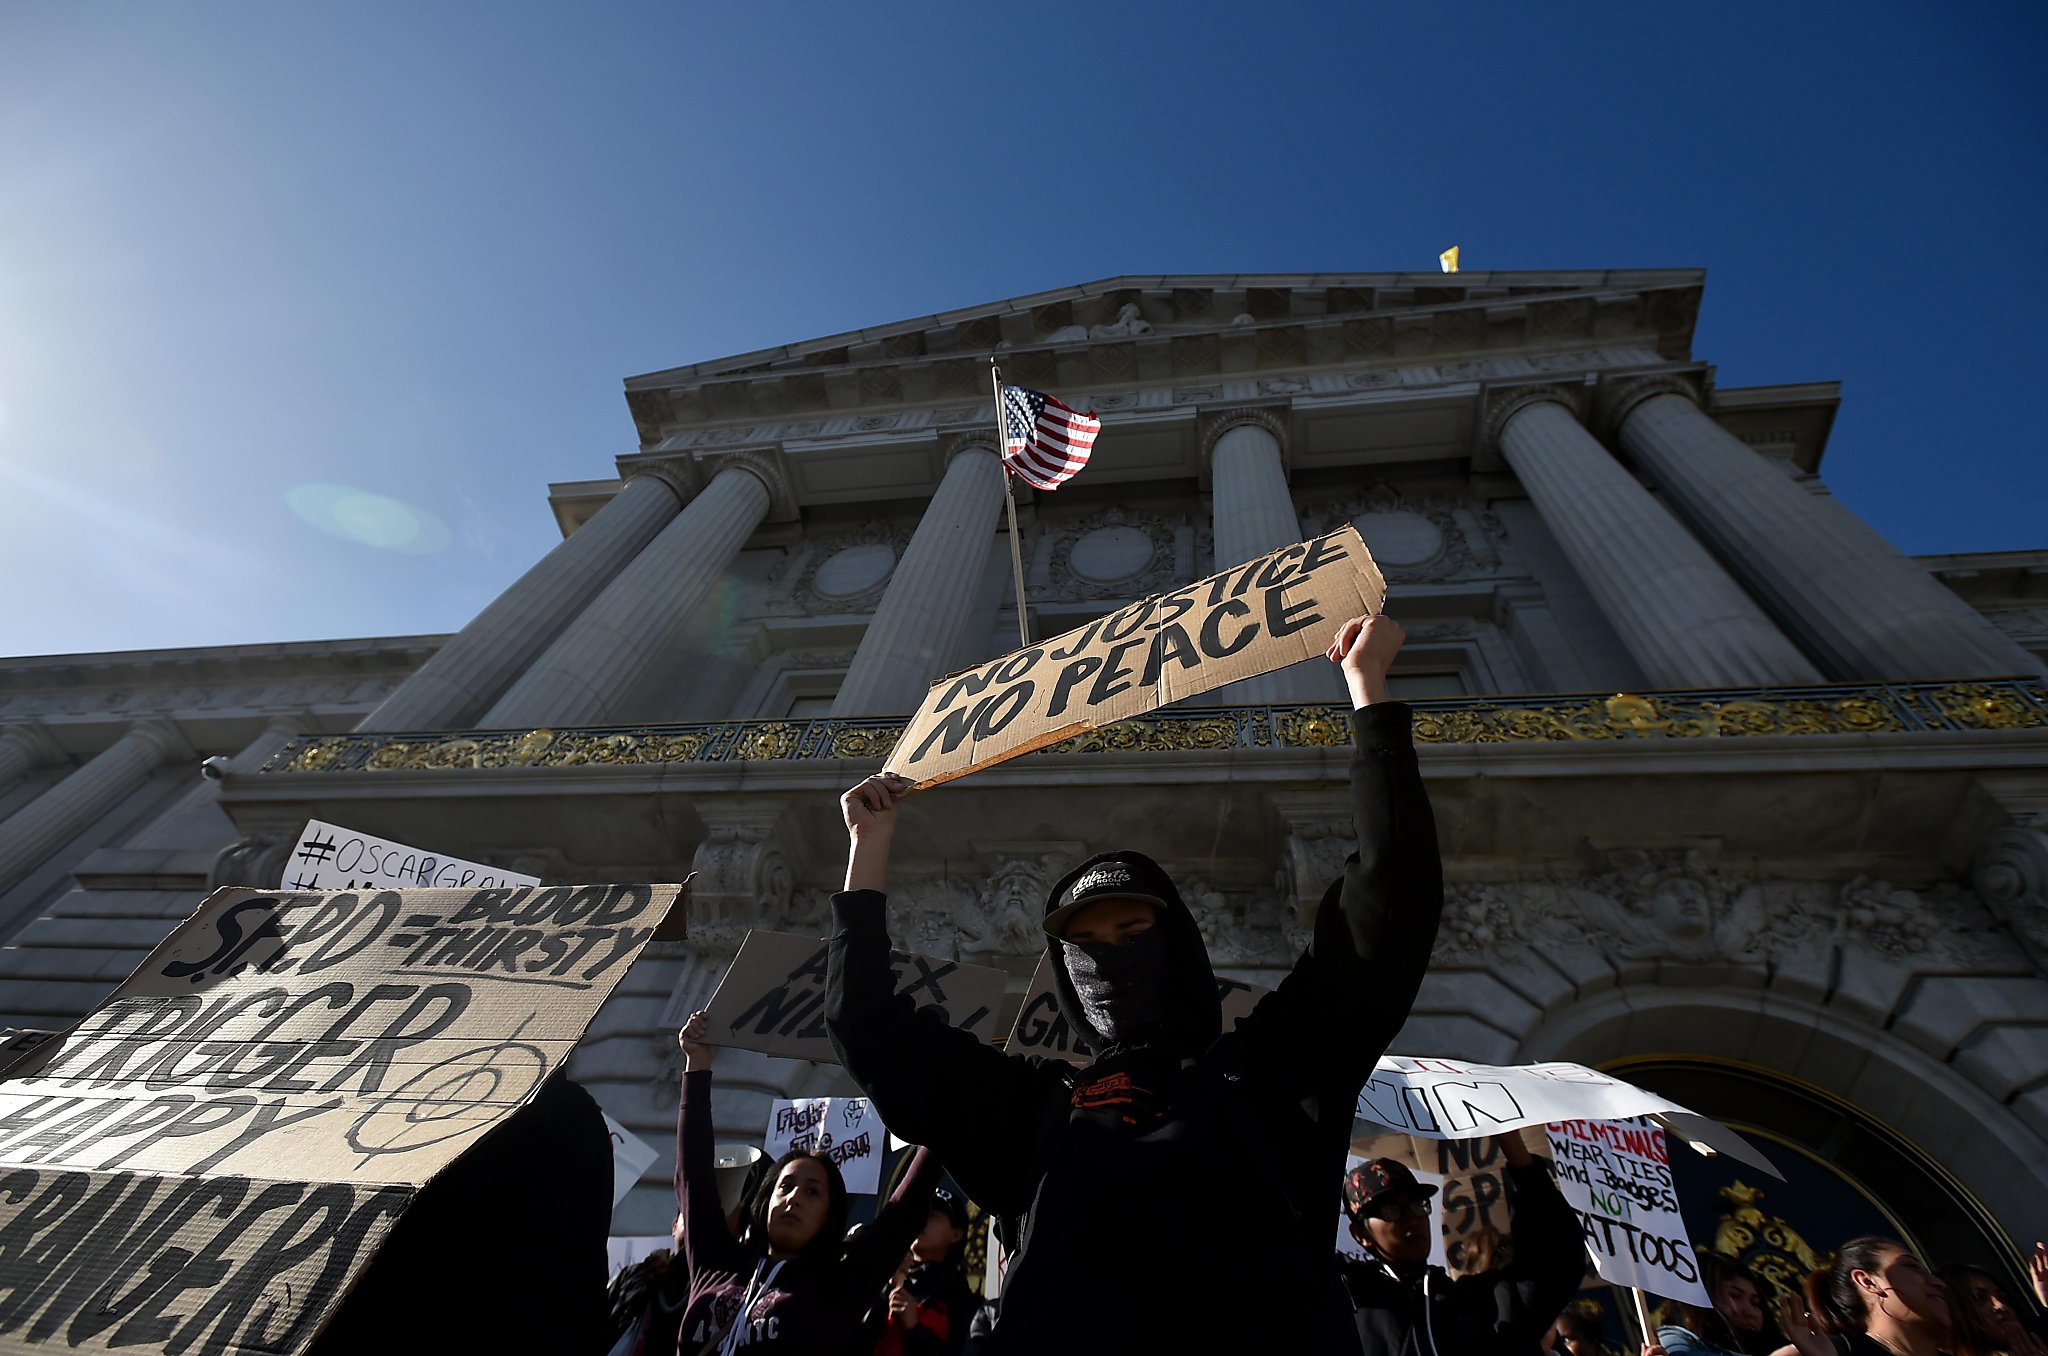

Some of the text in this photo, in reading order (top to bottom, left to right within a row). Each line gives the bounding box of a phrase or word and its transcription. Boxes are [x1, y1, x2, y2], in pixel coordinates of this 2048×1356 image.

[933, 529, 1349, 713] NO JUSTICE
[909, 572, 1325, 763] NO PEACE
[298, 828, 536, 889] #OSCARGR
[447, 884, 652, 927] BLOOD
[401, 926, 655, 980] THIRSTY
[20, 982, 472, 1096] TRIGGER
[1547, 1134, 1672, 1187] WEAR TIES
[1590, 1188, 1635, 1220] NOT
